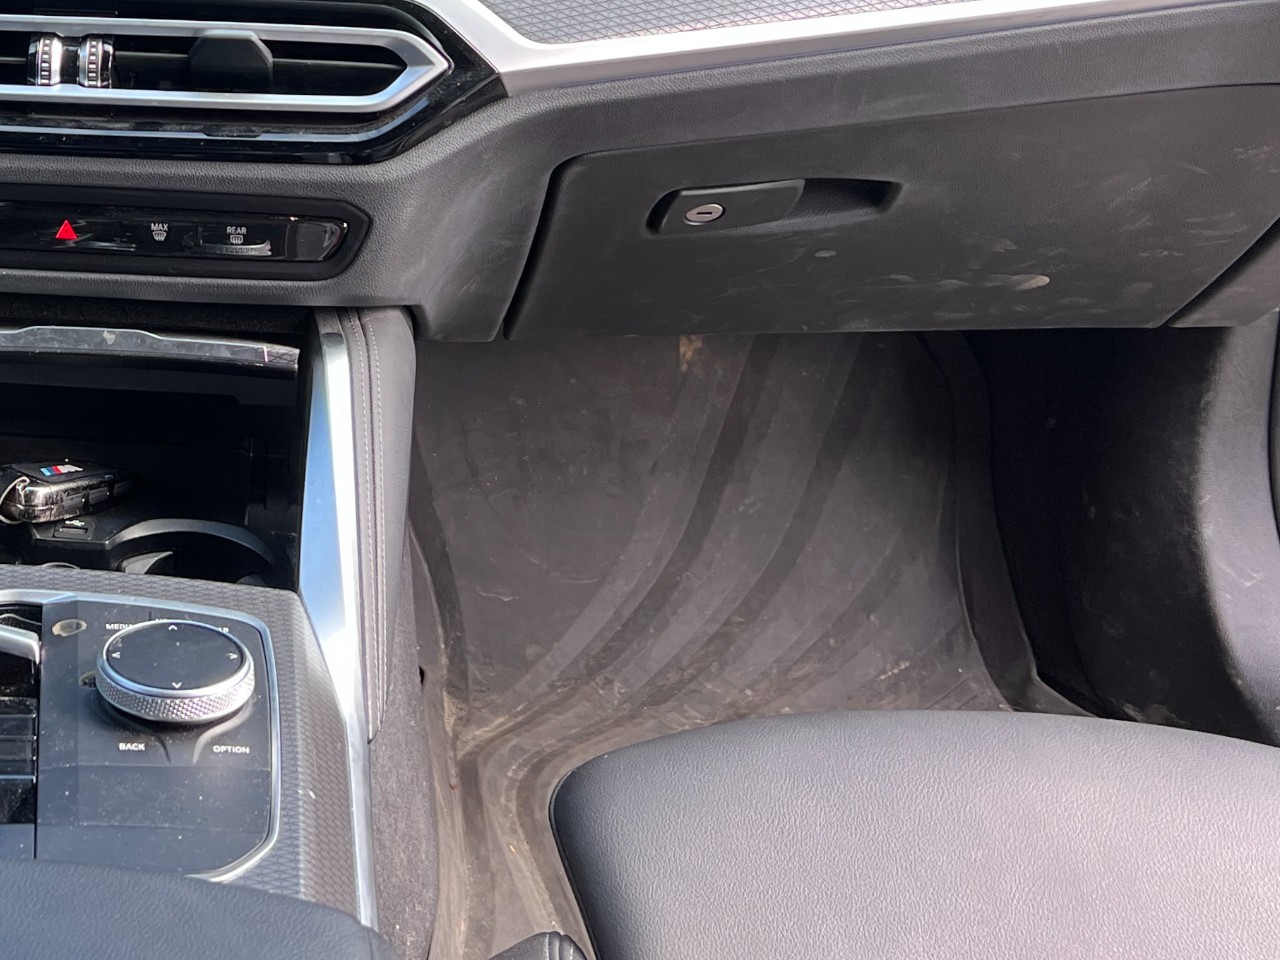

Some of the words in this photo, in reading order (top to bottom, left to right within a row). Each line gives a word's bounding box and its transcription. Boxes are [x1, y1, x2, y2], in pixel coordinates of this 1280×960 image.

[151, 222, 169, 231] MAX
[226, 226, 247, 234] REAR
[119, 742, 146, 751] BACK
[213, 745, 250, 754] OPTION
